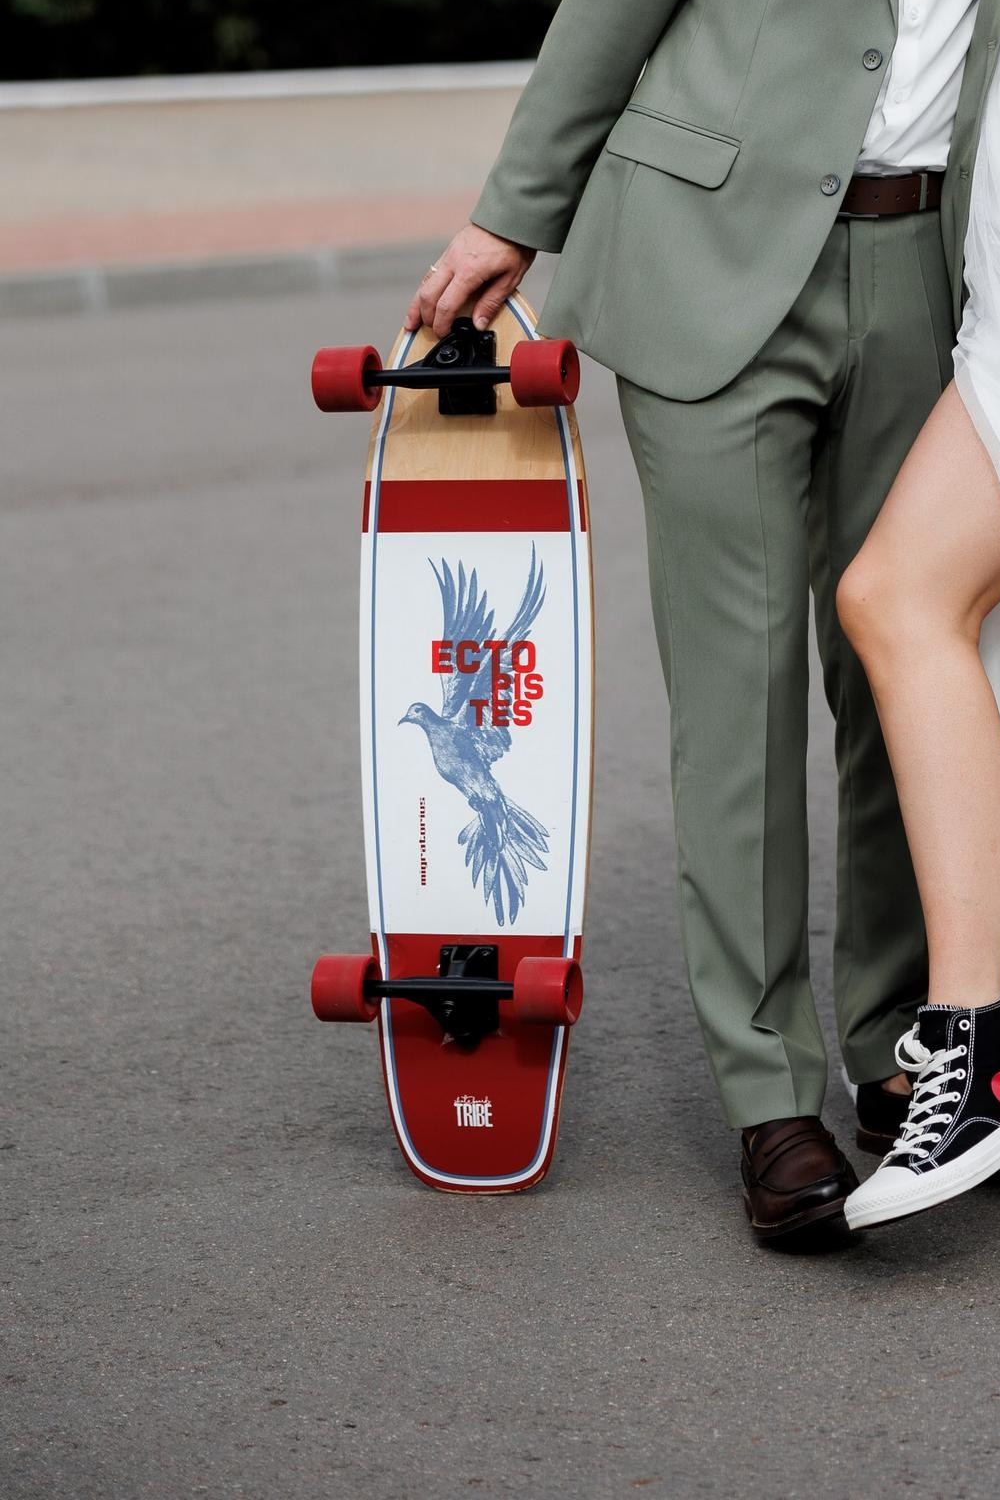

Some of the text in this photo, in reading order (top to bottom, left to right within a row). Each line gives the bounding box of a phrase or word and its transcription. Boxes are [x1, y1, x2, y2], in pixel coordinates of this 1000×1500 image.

[431, 640, 536, 674] ECTO
[491, 673, 544, 700] PIS
[469, 699, 533, 727] TES
[453, 1102, 494, 1127] TRIBE
